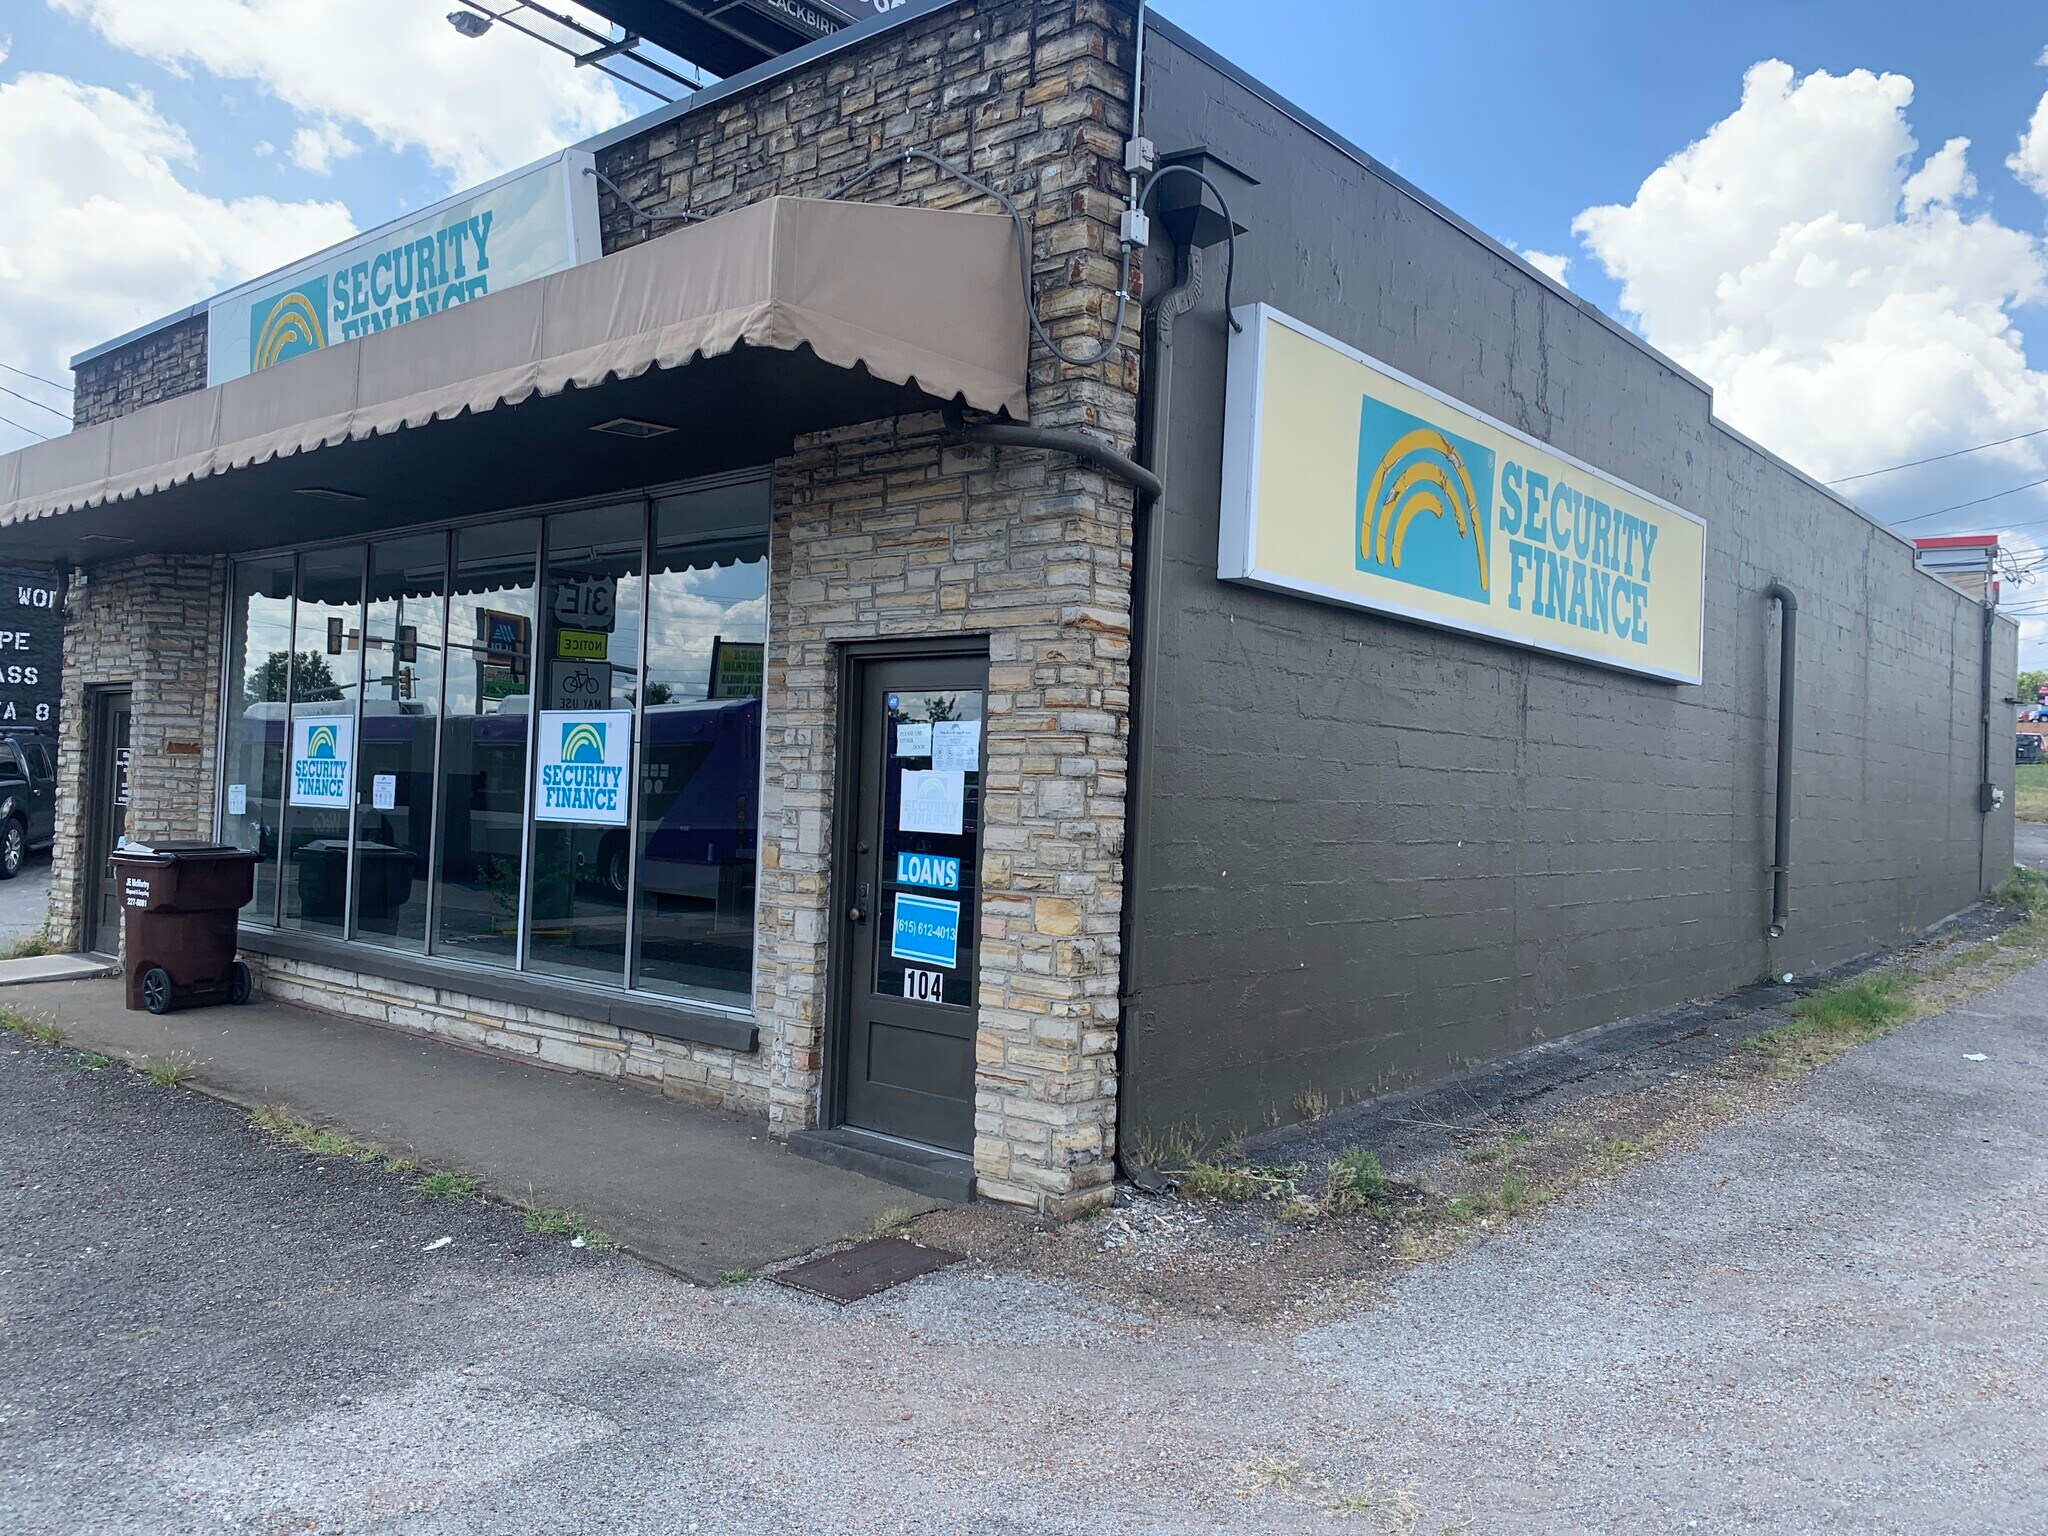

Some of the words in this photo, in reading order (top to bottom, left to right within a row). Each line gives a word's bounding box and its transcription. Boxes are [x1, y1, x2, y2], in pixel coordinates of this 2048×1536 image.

[333, 210, 493, 322] SECURITY
[1499, 460, 1658, 583] SECURITY
[1508, 538, 1648, 645] FINANCE
[0, 701, 17, 720] A
[35, 703, 50, 721] 8
[295, 760, 347, 779] SECURITY
[543, 764, 622, 788] SECURITY
[297, 777, 343, 797] FINANCE
[545, 787, 617, 810] FINANCE
[904, 800, 958, 815] SECURITY
[906, 812, 956, 827] FINANCE
[898, 855, 957, 888] LOANS
[896, 918, 917, 938] (615)
[918, 924, 956, 940] 612-4013
[907, 970, 942, 1002] 104
